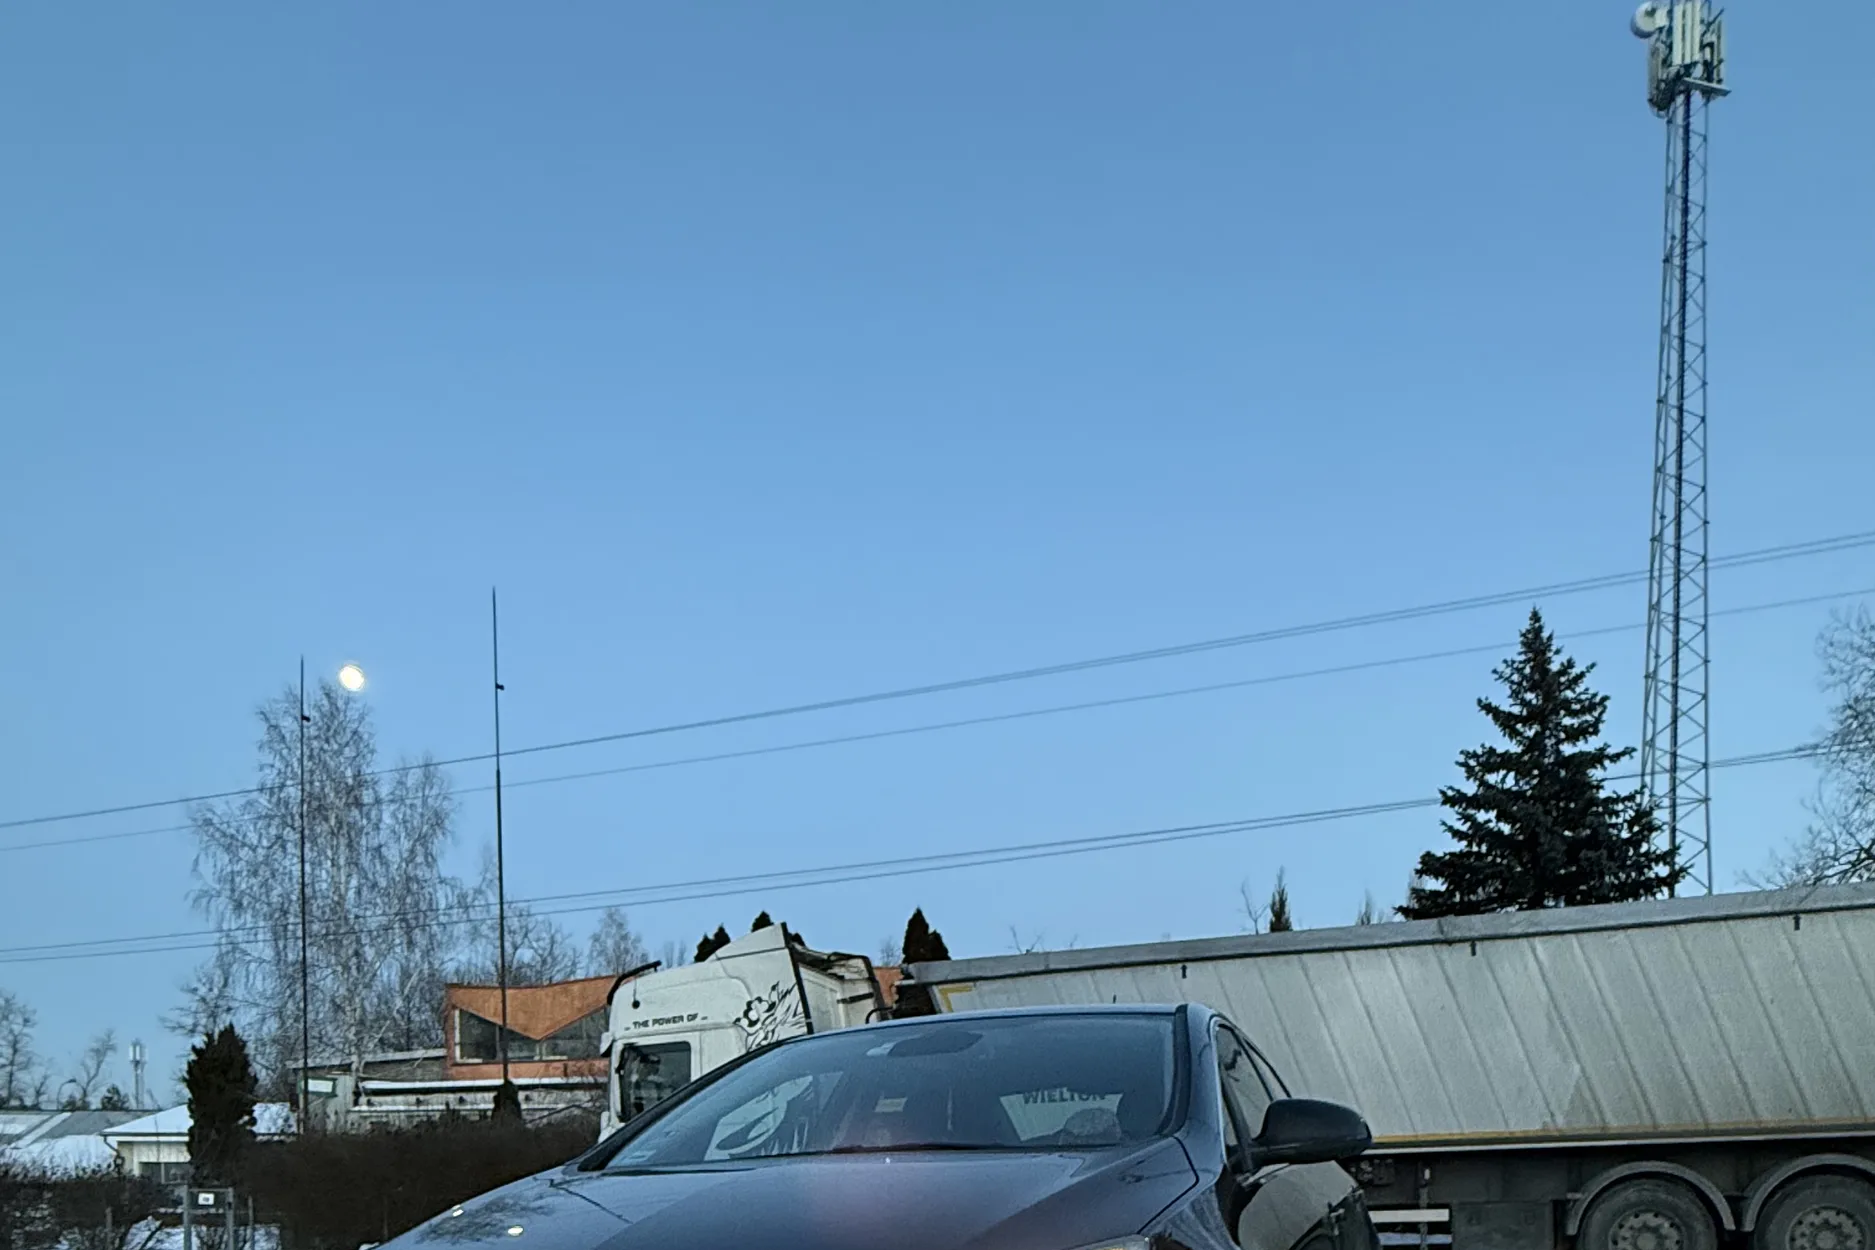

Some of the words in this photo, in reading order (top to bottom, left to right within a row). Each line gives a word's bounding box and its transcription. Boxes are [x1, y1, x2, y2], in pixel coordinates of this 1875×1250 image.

[632, 1019, 650, 1029] THE
[651, 1014, 685, 1027] POWER
[686, 1012, 699, 1022] OF
